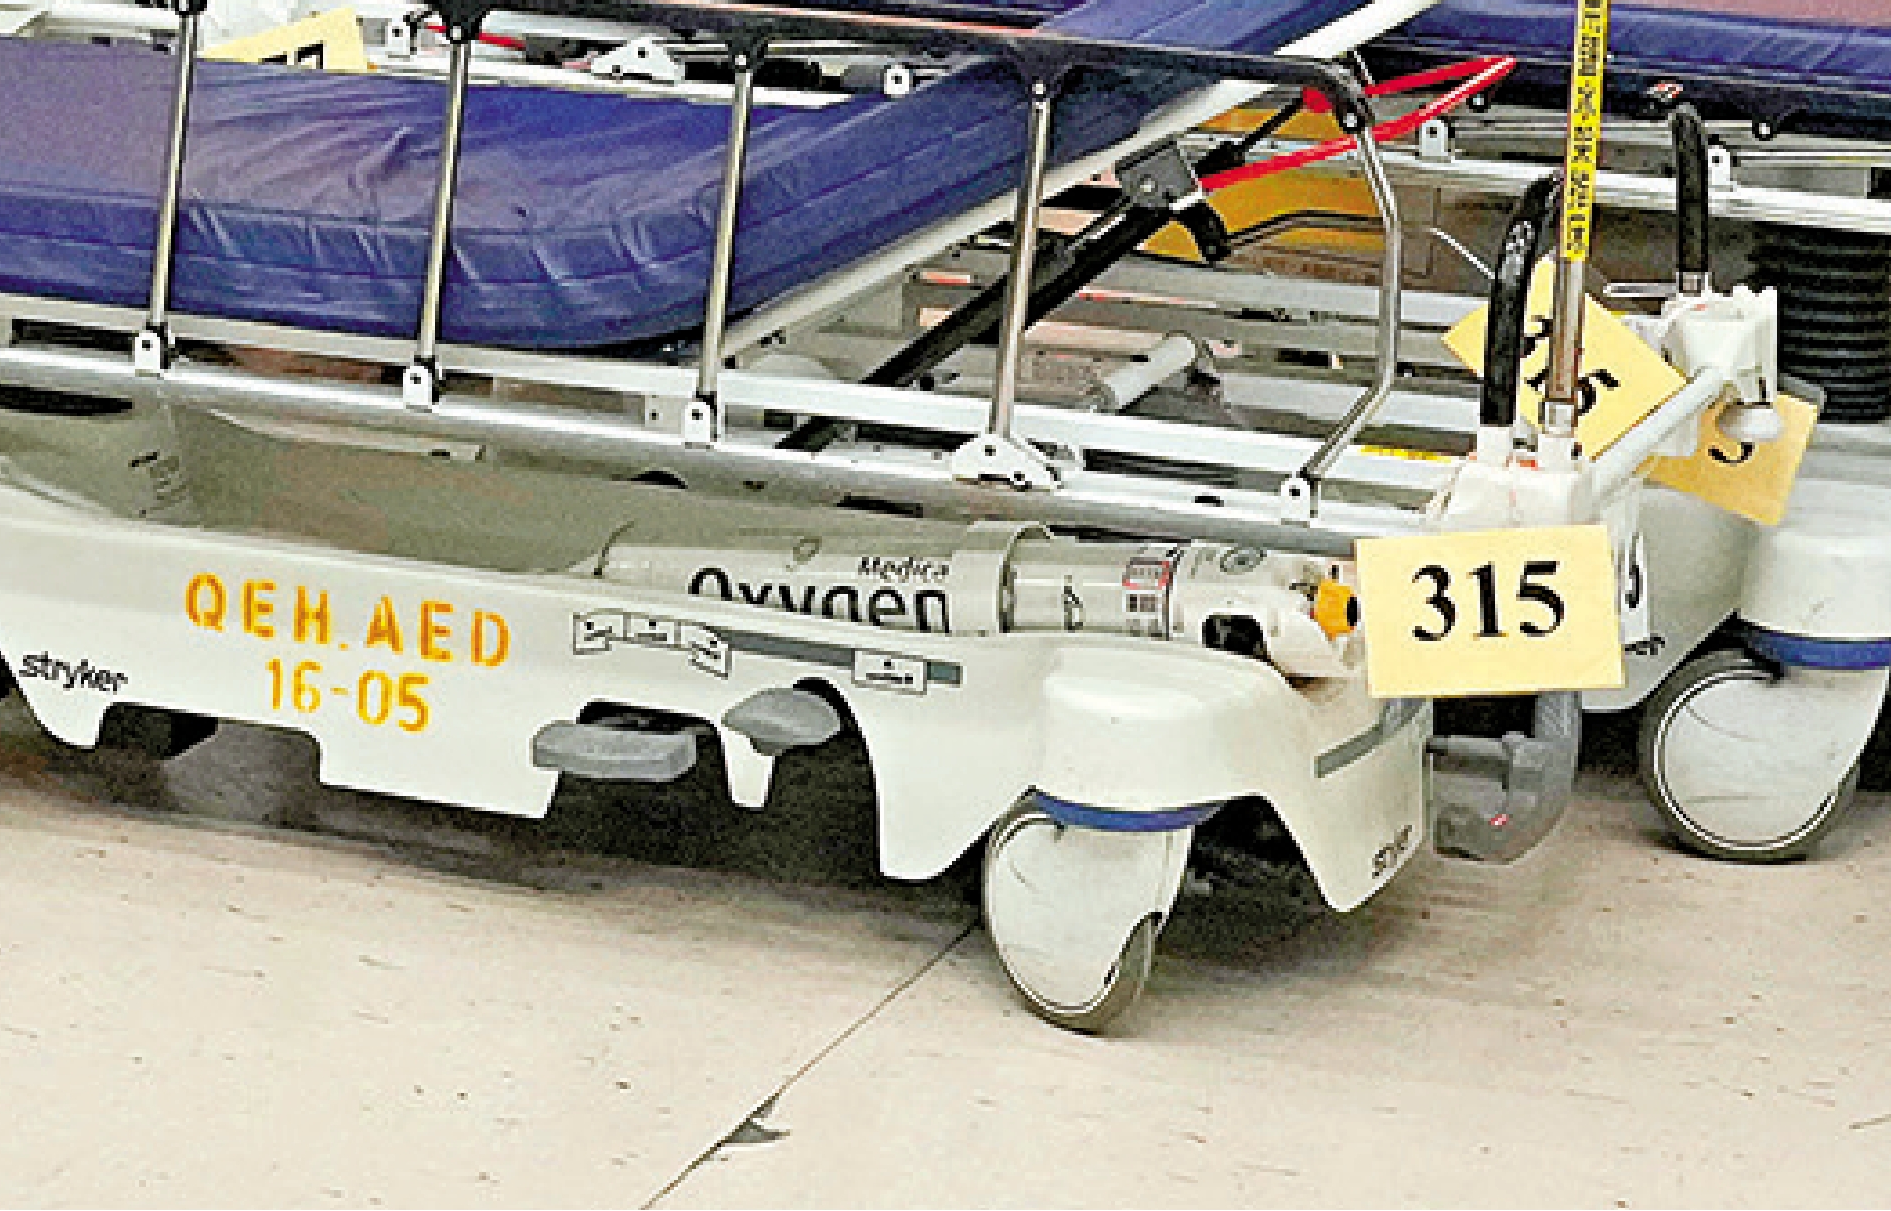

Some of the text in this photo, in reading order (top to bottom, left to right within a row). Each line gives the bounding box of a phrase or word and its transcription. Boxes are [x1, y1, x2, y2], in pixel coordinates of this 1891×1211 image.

[1412, 560, 1566, 642] 315
[19, 651, 129, 696] stryker
[267, 658, 433, 733] 16-05
